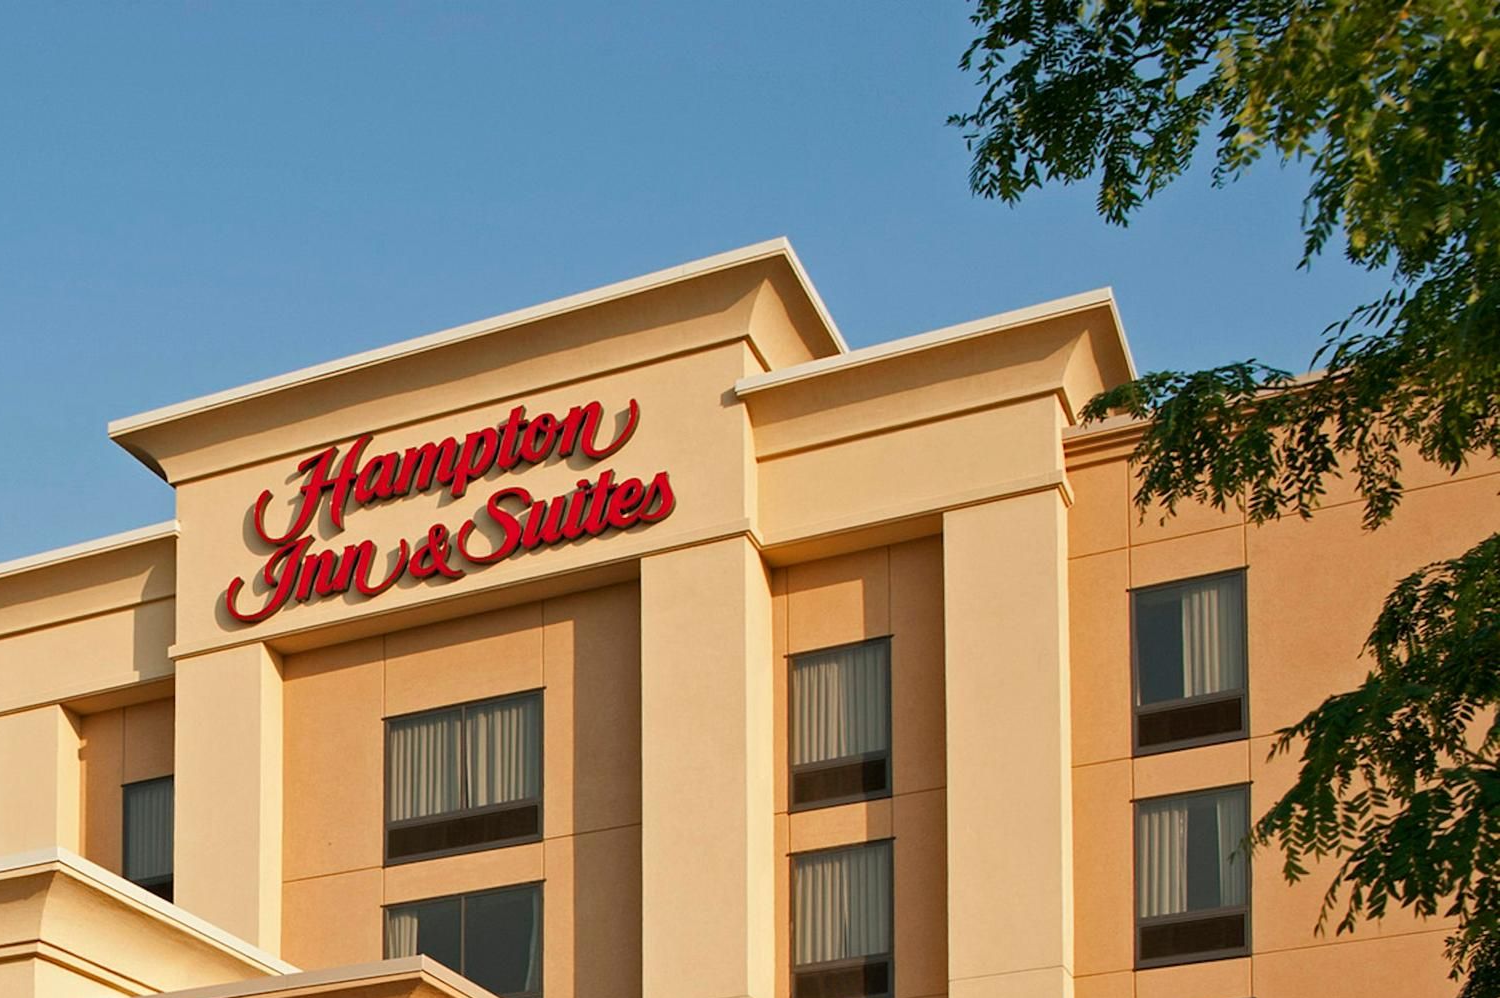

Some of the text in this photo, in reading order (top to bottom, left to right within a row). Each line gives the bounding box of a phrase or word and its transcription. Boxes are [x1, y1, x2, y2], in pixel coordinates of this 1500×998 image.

[226, 469, 675, 622] Inn & Suites
[254, 398, 638, 545] Hampton
